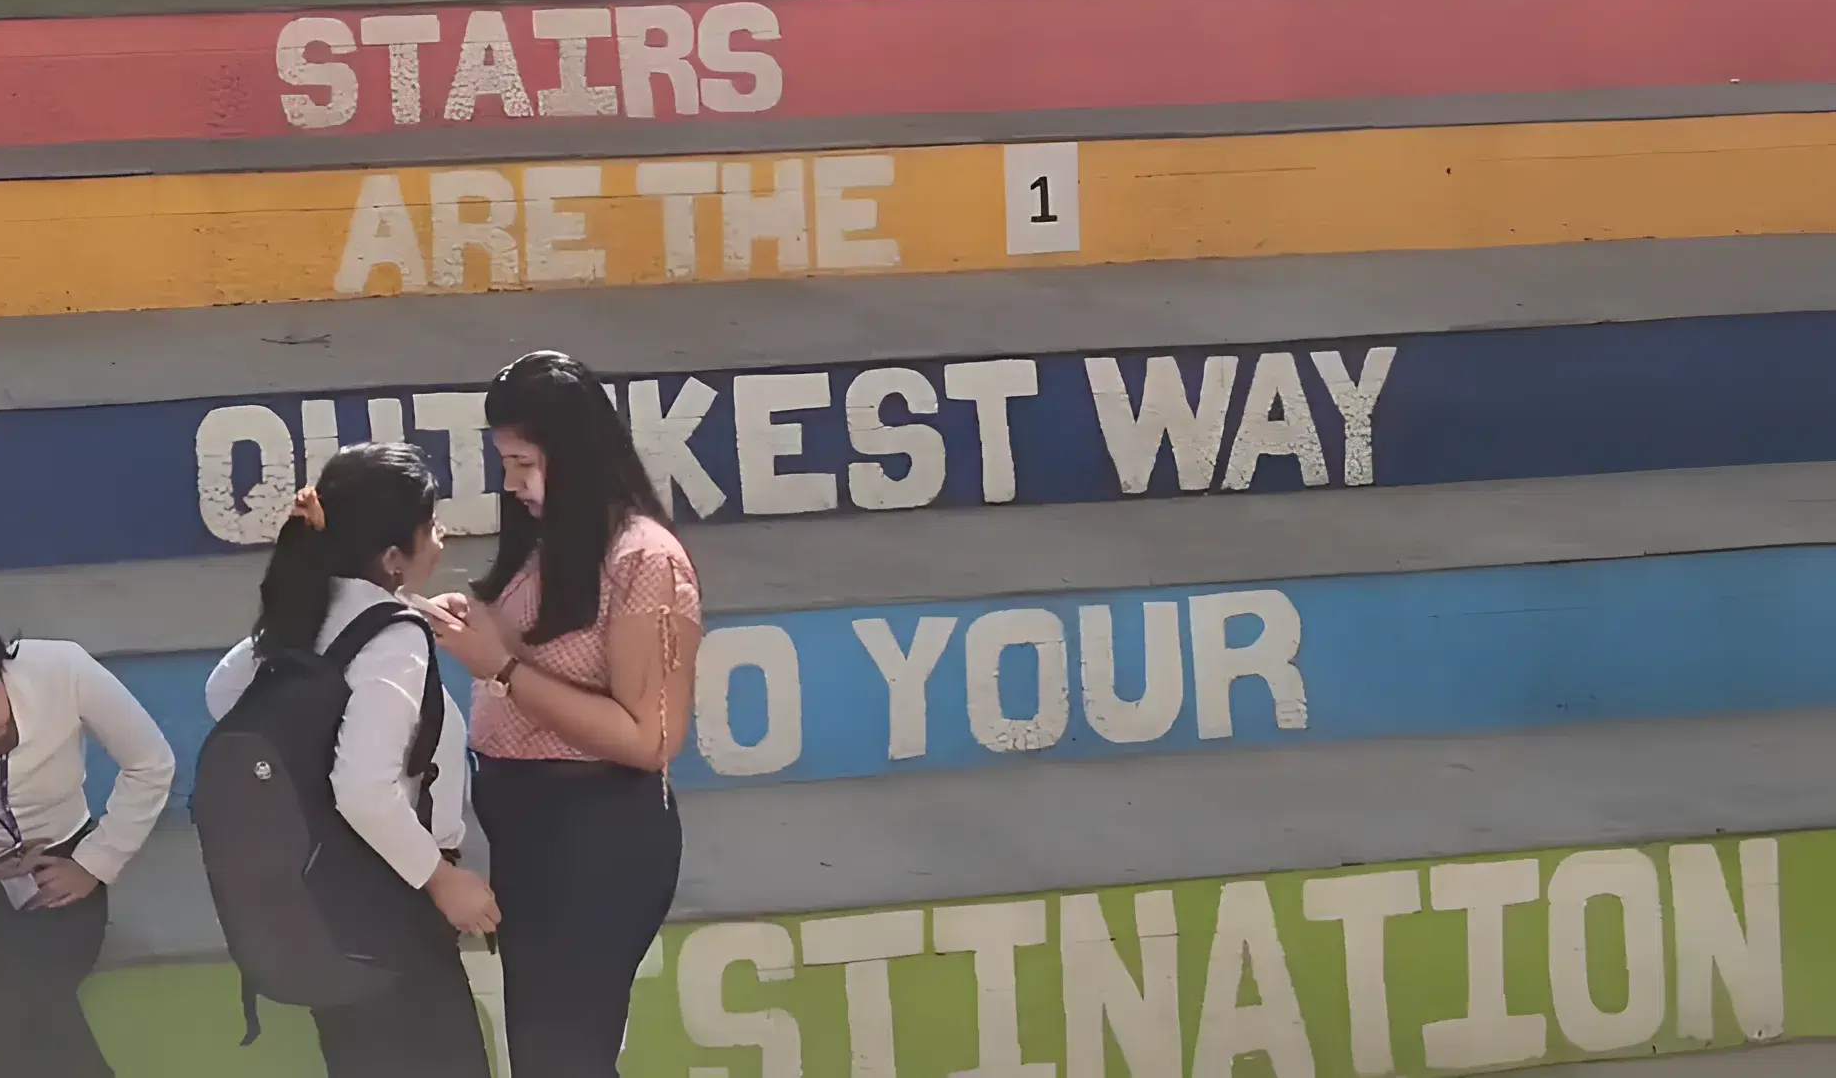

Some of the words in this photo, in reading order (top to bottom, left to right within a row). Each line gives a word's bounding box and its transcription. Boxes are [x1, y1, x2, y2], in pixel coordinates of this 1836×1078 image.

[275, 2, 782, 129] STAIRS
[333, 163, 606, 294] ARE
[636, 154, 901, 283] THE
[1028, 175, 1058, 224] 1
[196, 358, 1037, 547] QIKEST
[1085, 346, 1397, 495] WAY
[694, 624, 802, 776] O
[852, 588, 1308, 759] YOUR
[460, 837, 1783, 1078] STINATION
